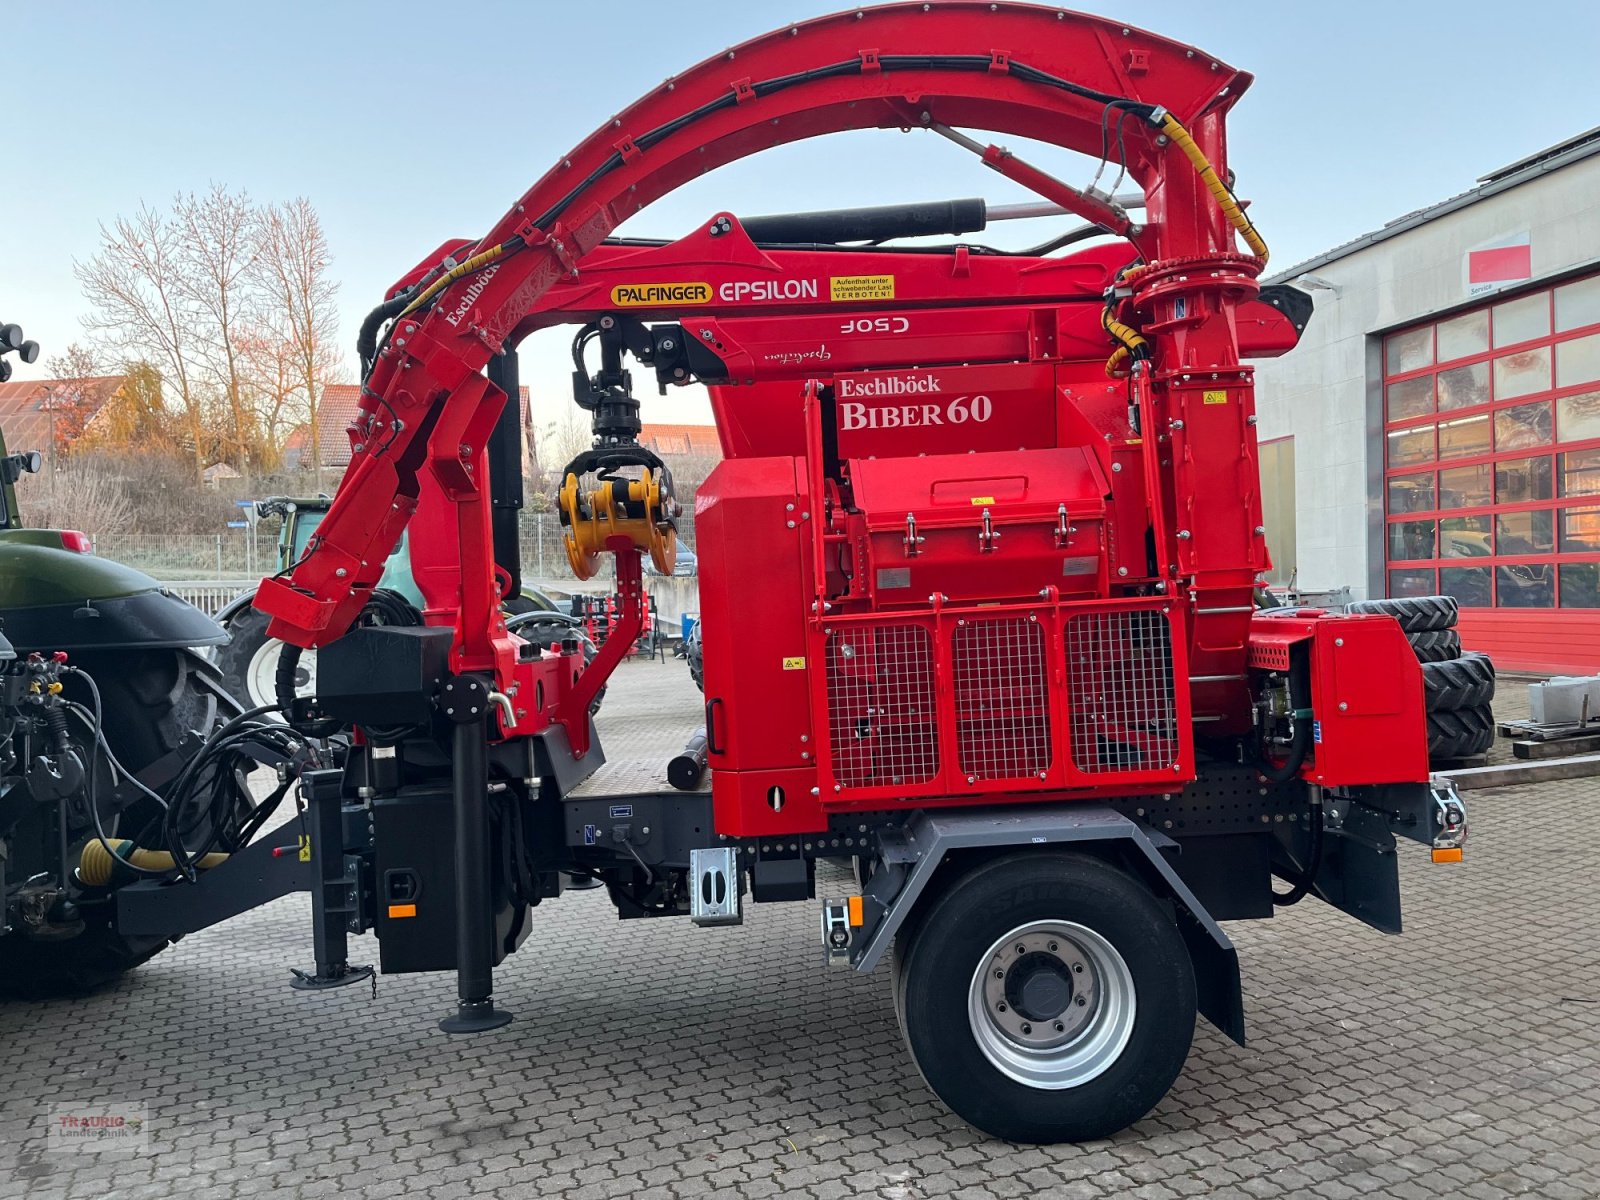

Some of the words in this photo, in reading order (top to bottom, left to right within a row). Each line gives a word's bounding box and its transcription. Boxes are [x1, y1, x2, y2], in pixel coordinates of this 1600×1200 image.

[617, 286, 706, 302] PALFINGER
[719, 279, 818, 301] EPSILON
[1471, 284, 1492, 295] Service
[840, 375, 941, 397] Eschlböck
[840, 402, 944, 431] BIBER
[947, 395, 992, 424] 60
